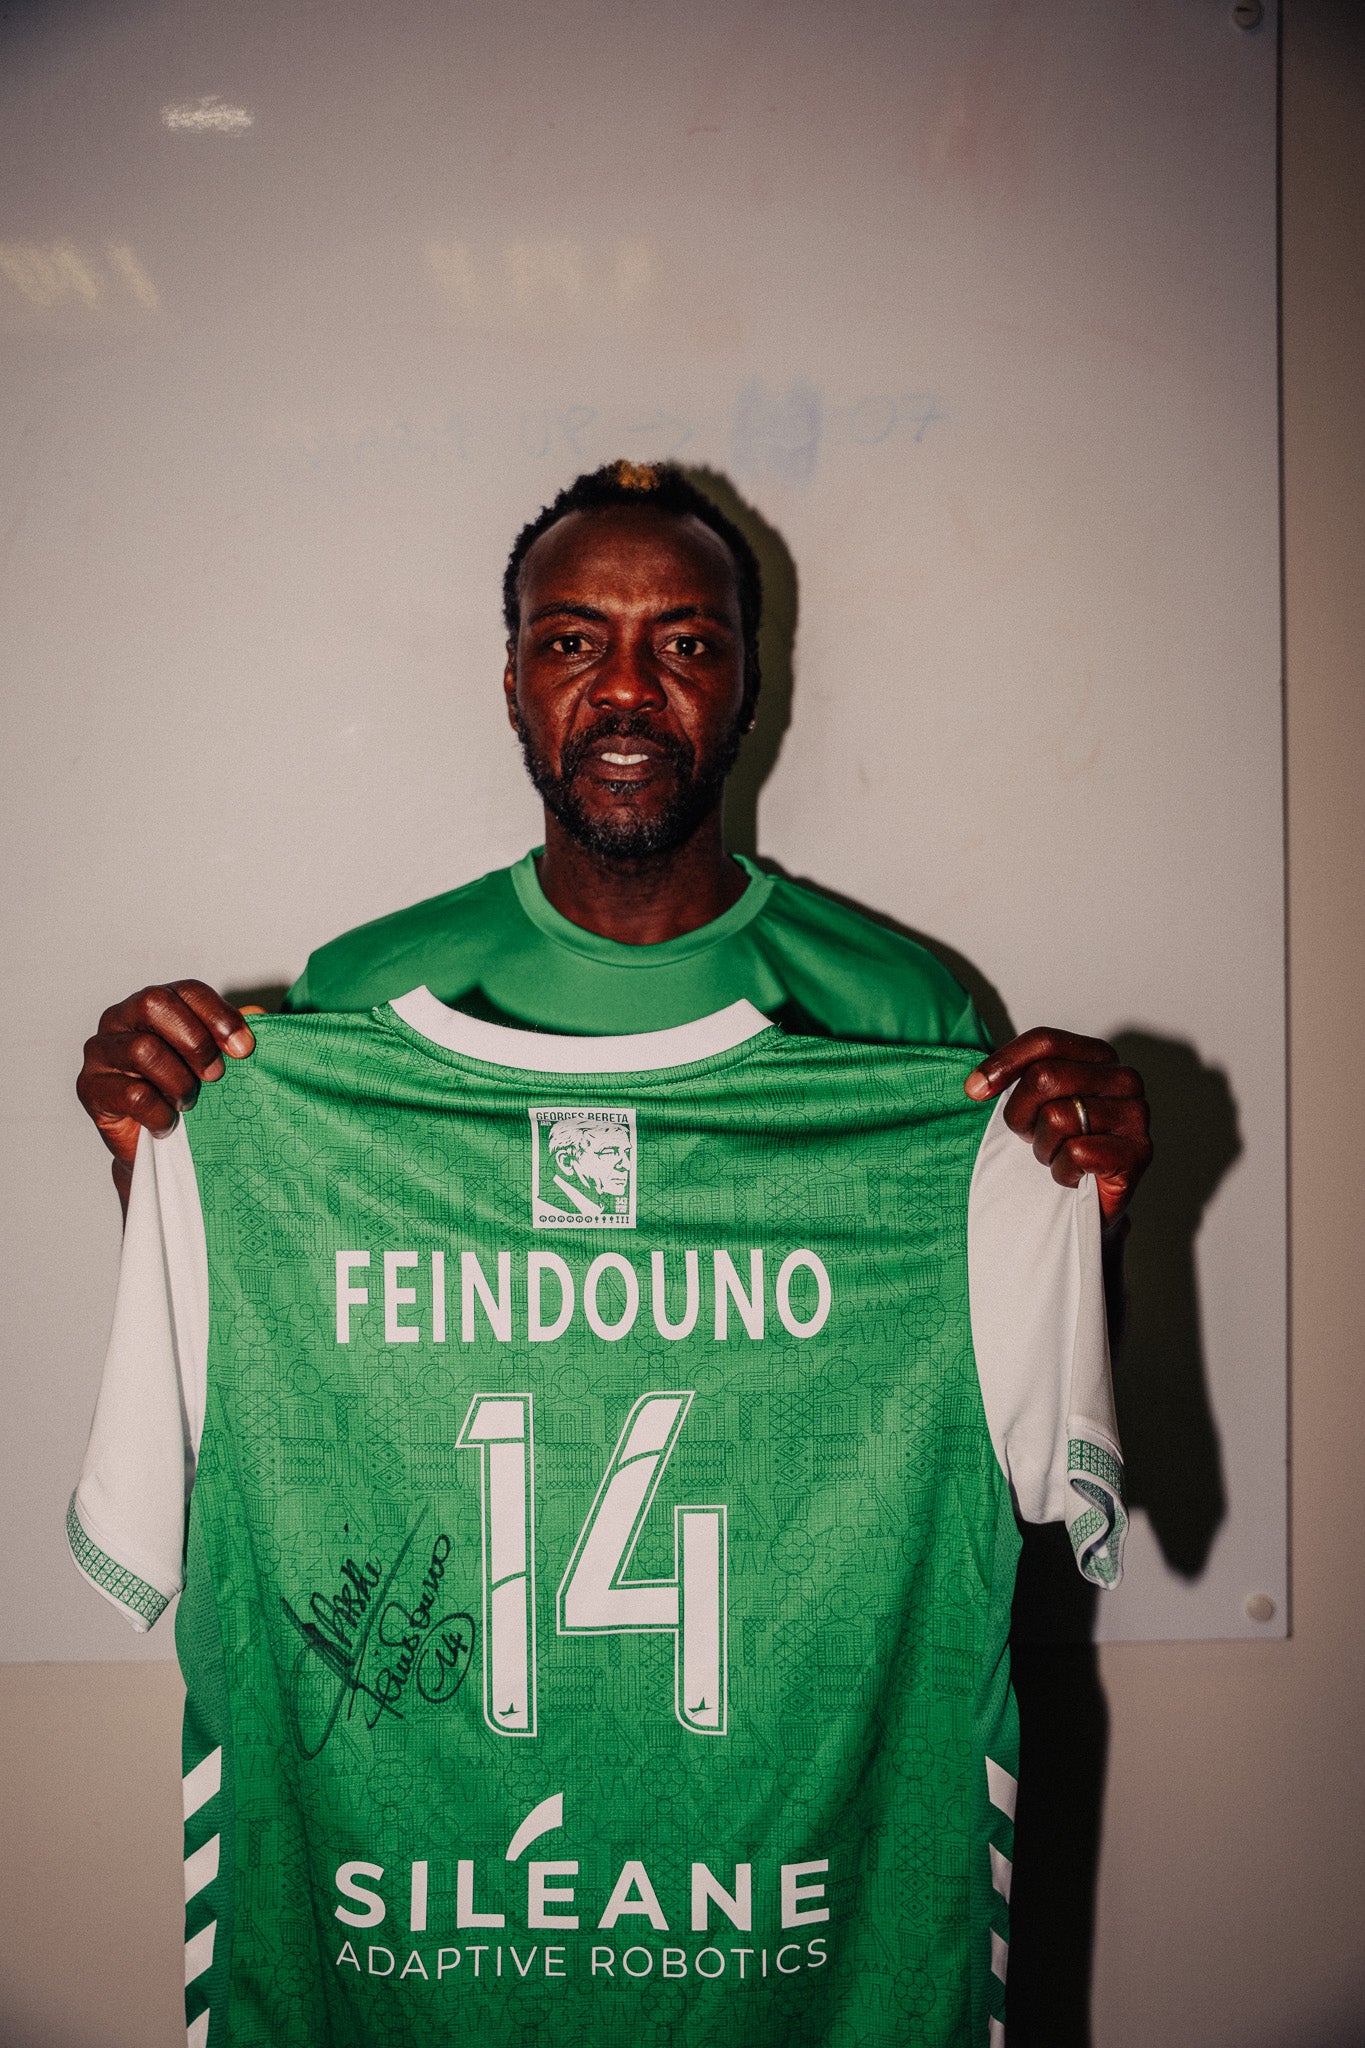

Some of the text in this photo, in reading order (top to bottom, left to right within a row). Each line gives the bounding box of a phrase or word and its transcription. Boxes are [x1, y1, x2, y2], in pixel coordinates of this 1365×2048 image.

[536, 1111, 629, 1123] GEORGES BERETA
[334, 1248, 832, 1344] FEINDOUNO
[454, 1390, 728, 1738] 14
[335, 1792, 830, 1932] SILÉANE
[336, 1938, 828, 1980] ADAPTIVE ROBOTICS
